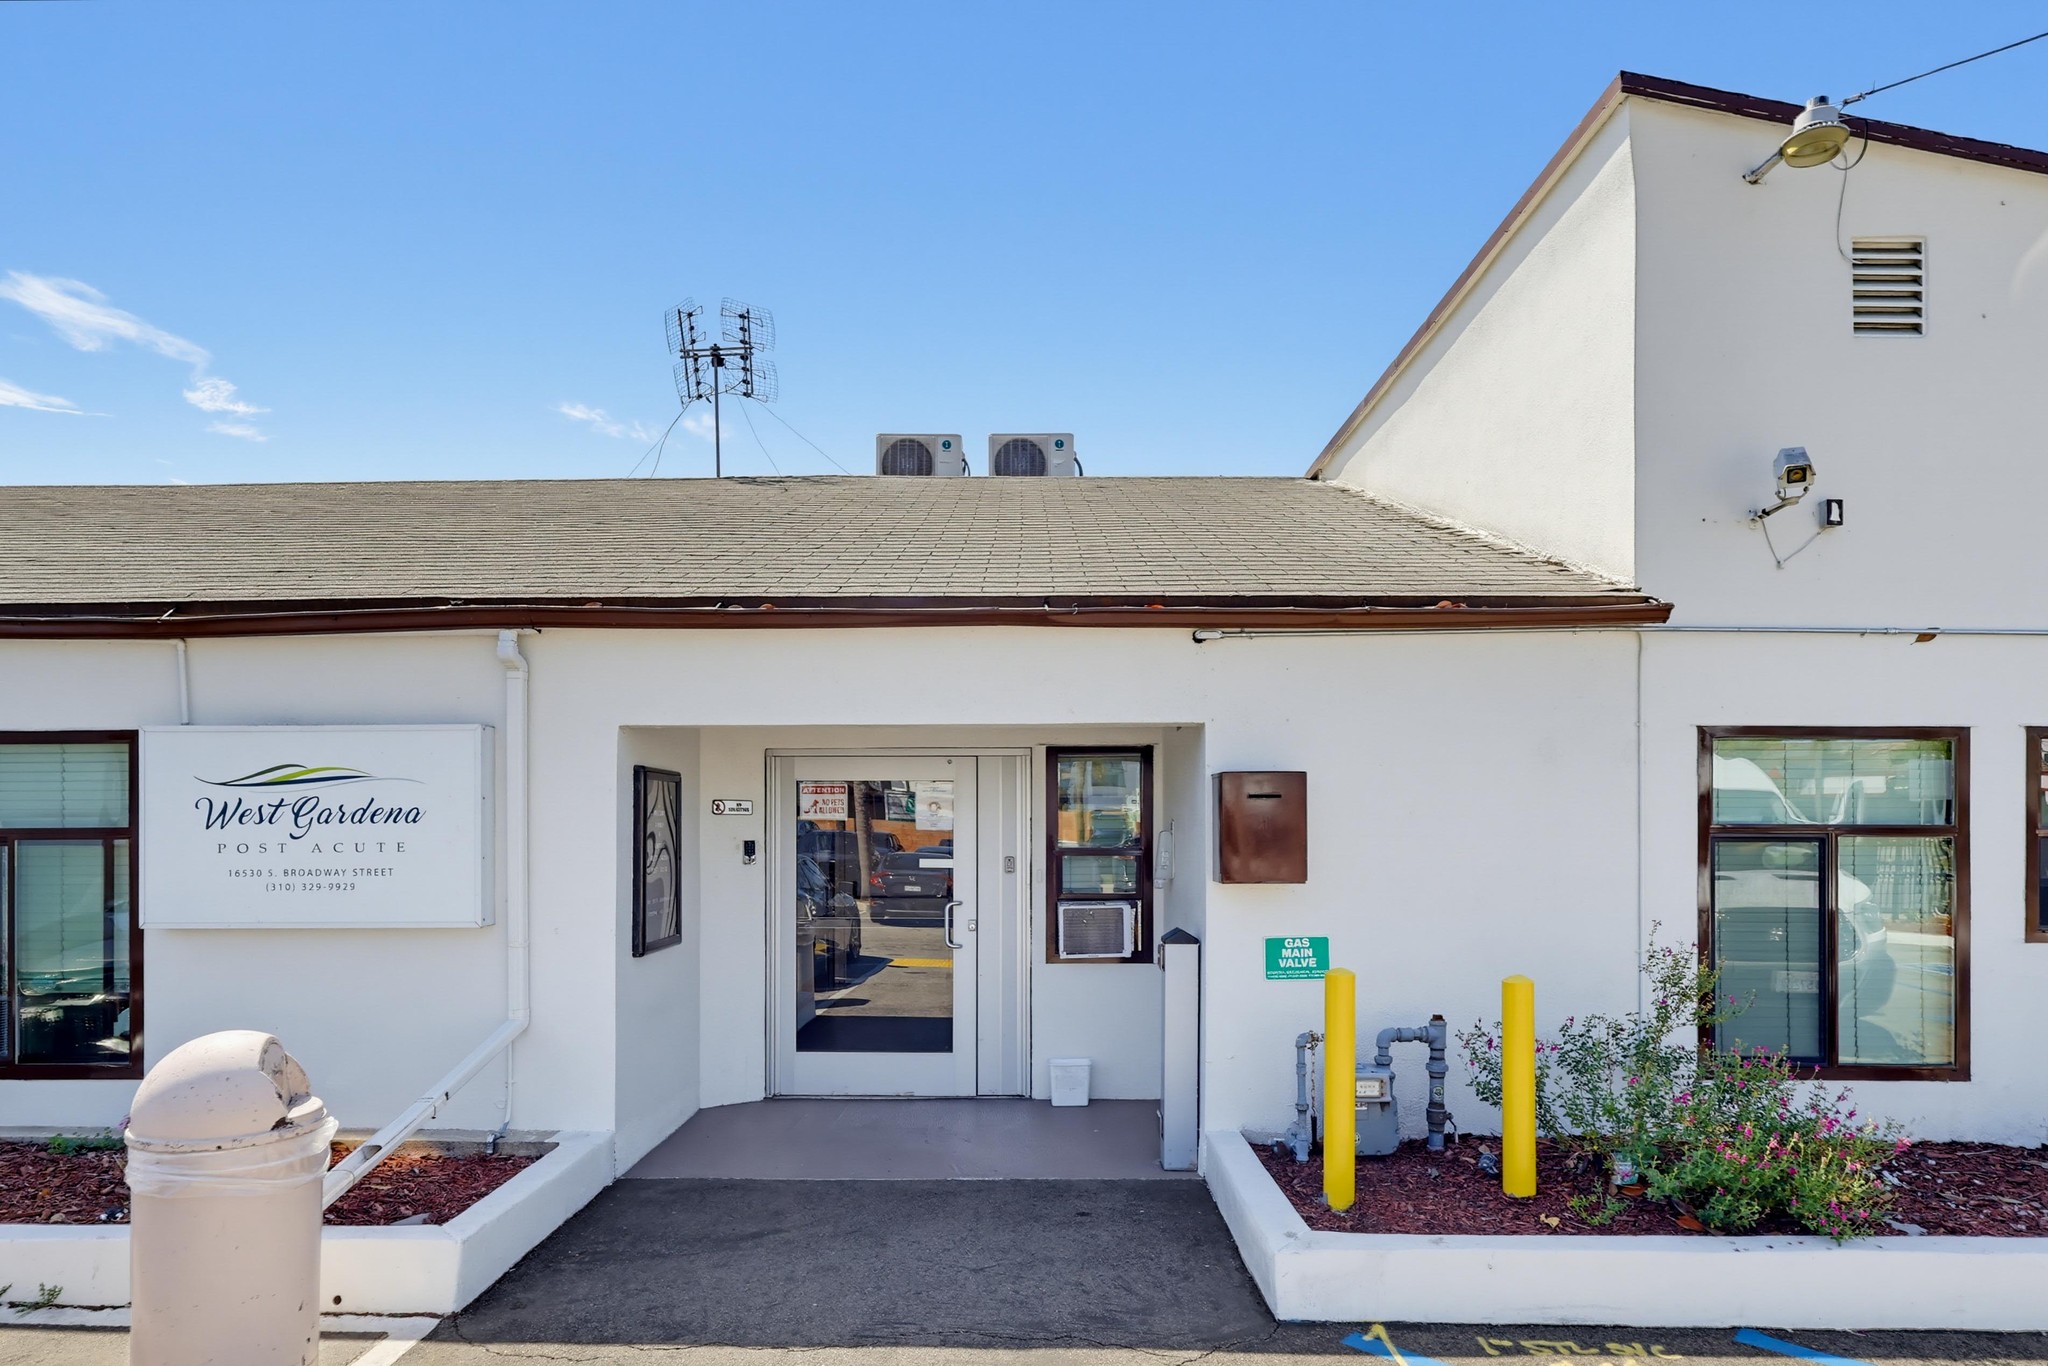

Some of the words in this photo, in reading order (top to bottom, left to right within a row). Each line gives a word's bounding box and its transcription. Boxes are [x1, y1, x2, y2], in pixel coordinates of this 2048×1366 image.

[802, 786, 845, 794] ATTENTION
[821, 798, 830, 806] NO
[195, 797, 293, 830] West
[289, 796, 426, 840] Gardena
[217, 842, 288, 854] POST
[311, 841, 406, 854] ACUTE
[228, 868, 263, 877] 16530
[267, 868, 278, 877] S.
[283, 868, 347, 877] BROADWAY
[352, 867, 395, 877] STREET
[265, 882, 296, 892] (310)
[301, 882, 356, 891] 329-9929
[1284, 938, 1310, 948] GAS
[1281, 948, 1313, 958] MAIN
[1278, 957, 1317, 968] VALVE
